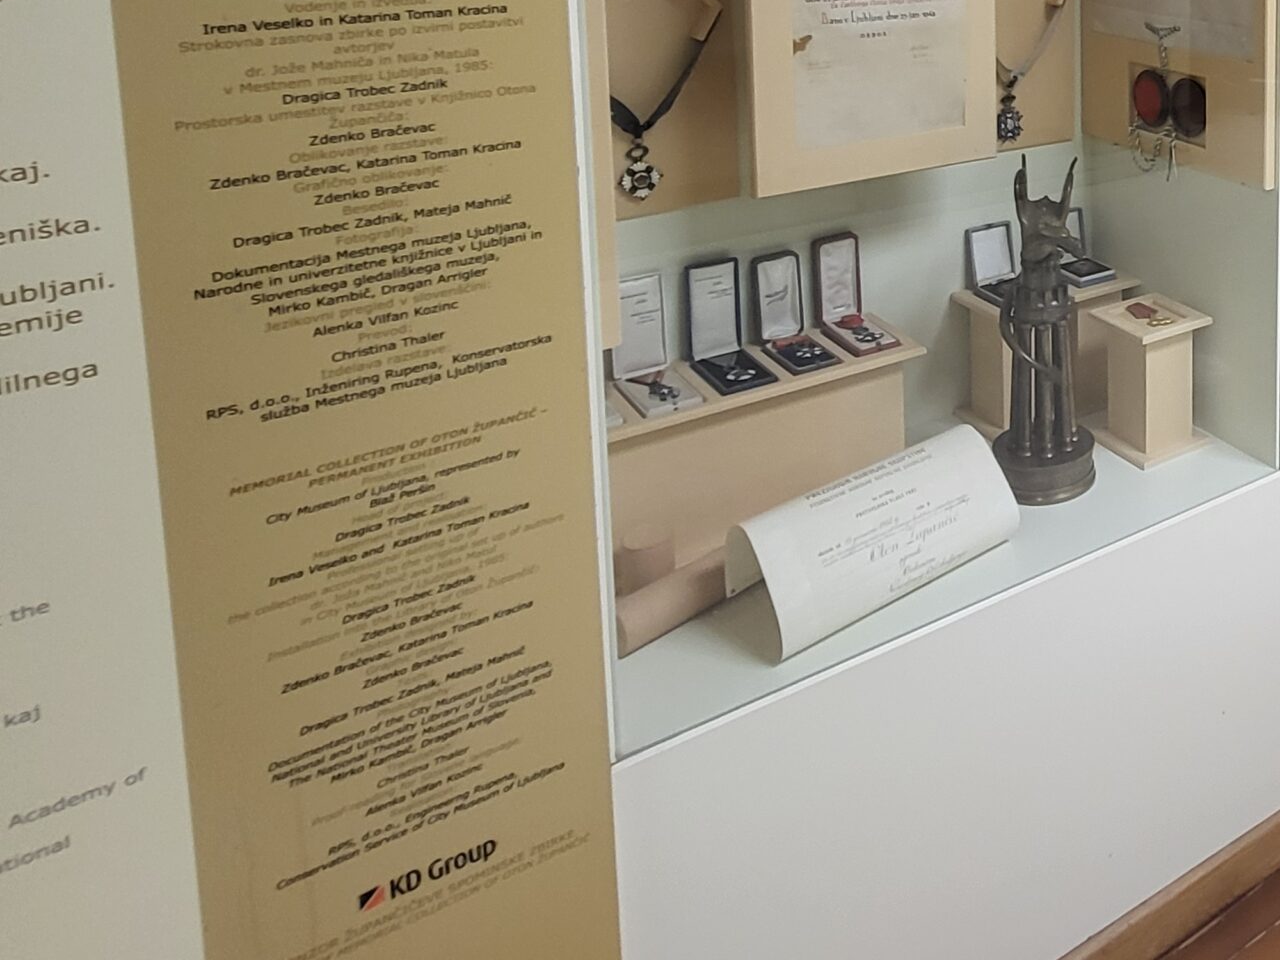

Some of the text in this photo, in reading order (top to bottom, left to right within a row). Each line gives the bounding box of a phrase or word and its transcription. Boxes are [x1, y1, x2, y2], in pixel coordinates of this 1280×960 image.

[202, 4, 508, 35] Irena Veselko in Katarina Toman Kracina
[282, 78, 448, 105] Dragica Trobec Zadnik
[308, 123, 436, 147] Zdenko Bračevac
[209, 140, 521, 190] Zdenko Bračevac, Katarina Toman Kracina
[313, 179, 440, 206] Zdenko Bračevac
[233, 193, 512, 248] Dragica Trobec Zadnik, Mateja Mahnič
[194, 230, 542, 300] Narodne in univerzitetne knjižnice v Ljubljani in
[211, 220, 531, 283] Dokumentacija Mestnega muzeja Ljubljana,
[0, 272, 115, 306] ubljani.
[250, 252, 499, 305] Slovenskega gledališkega muzeja,
[268, 301, 311, 317] Mirko
[316, 287, 376, 307] Kambič,
[381, 278, 432, 295] Dragan
[312, 301, 459, 338] Alenka Vilfan Kozinc
[331, 330, 446, 362] Christina Thaler
[206, 404, 244, 420] RPS,
[305, 373, 380, 398] Inženiring
[385, 361, 443, 380] Rupena,
[452, 334, 552, 364] Konservatorska
[260, 357, 508, 422] služba Mestnega muzeja Ljubljana
[229, 406, 538, 497] MEMORIAL COLLECTION OF OTON ŽUPANČIČ
[308, 457, 396, 488] PERMANENT
[400, 435, 482, 464] EXHIBITION
[10, 600, 50, 622] the
[3, 704, 41, 728] kaj
[8, 767, 148, 829] Academy of
[389, 839, 498, 900] KD Group
